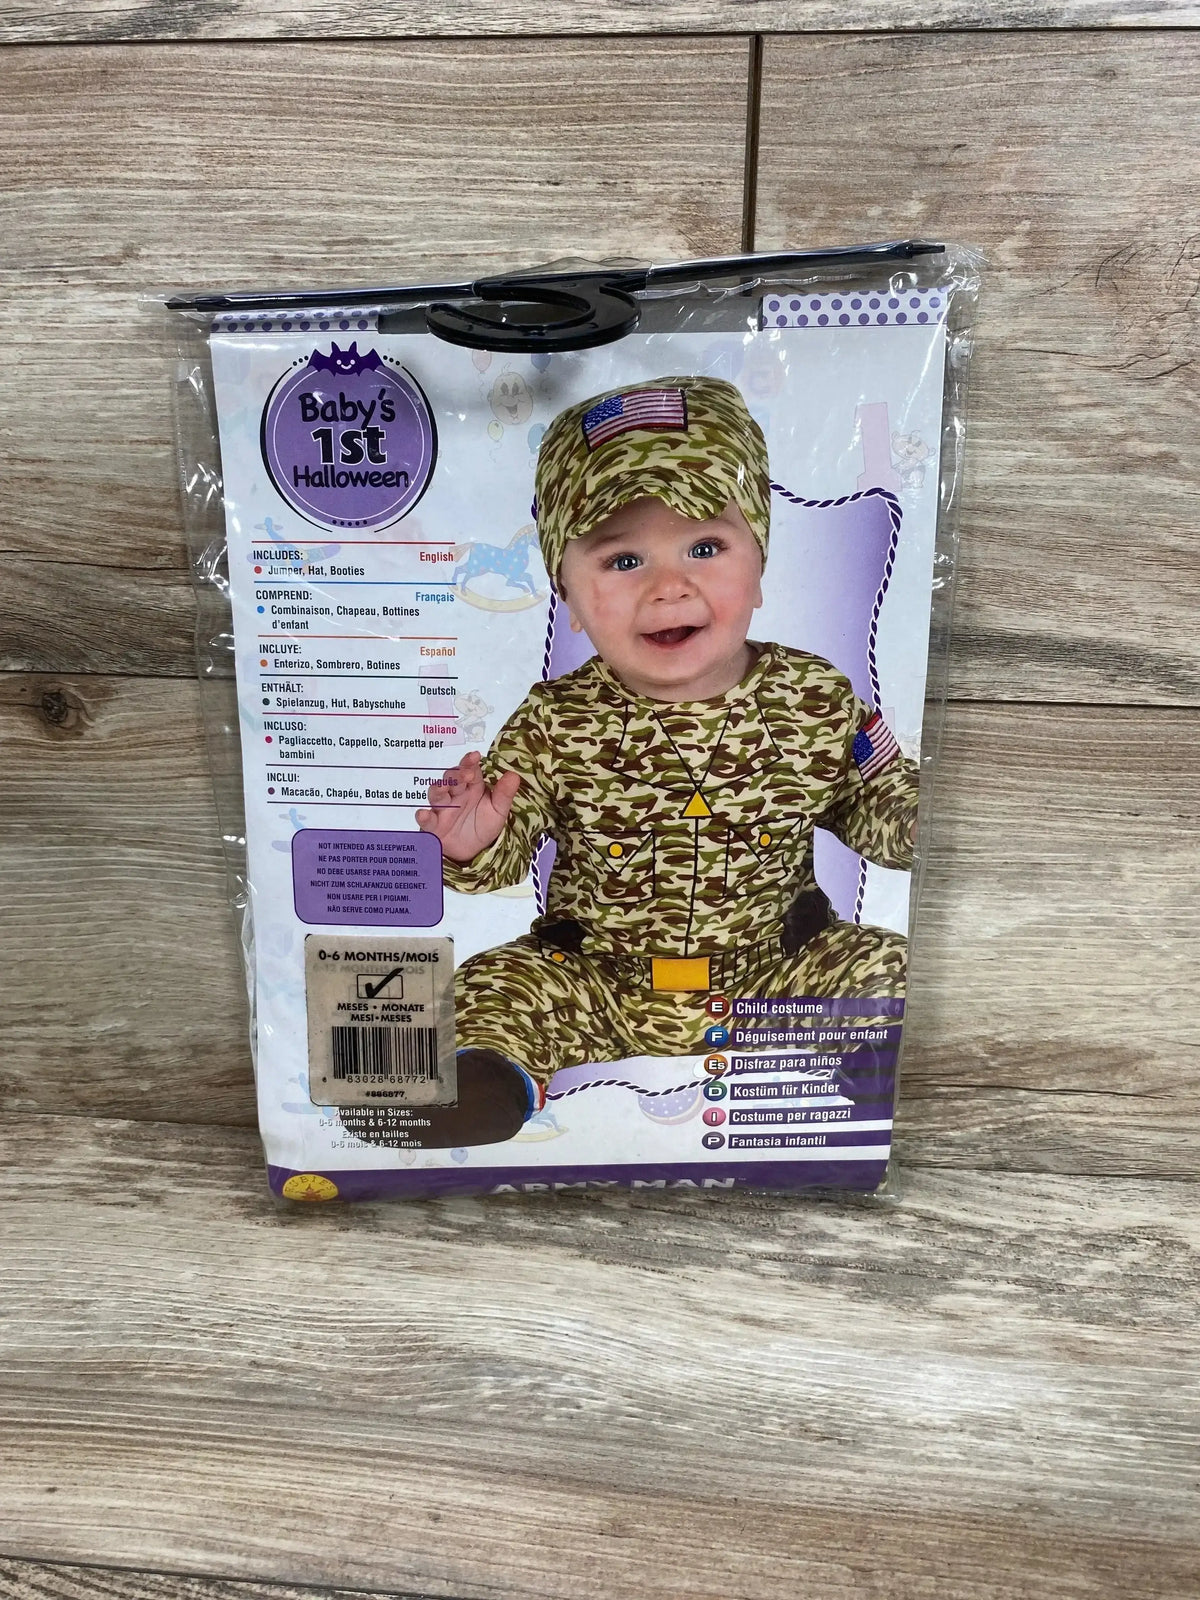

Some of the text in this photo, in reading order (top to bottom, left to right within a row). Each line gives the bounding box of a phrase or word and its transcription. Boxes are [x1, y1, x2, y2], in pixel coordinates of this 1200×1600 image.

[298, 388, 396, 430] Baby's
[311, 425, 388, 465] 1st
[293, 465, 409, 488] Halloween
[253, 550, 304, 560] INCLUDES:
[419, 552, 454, 564] English
[268, 566, 365, 577] Jumper, Hat, Booties
[255, 590, 312, 600] COMPREND:
[415, 592, 455, 604] Français
[271, 605, 420, 619] Combinaison, Chapeau, Bottines
[272, 620, 309, 630] d'enfant
[259, 644, 302, 654] INCLUYE:
[420, 647, 456, 659] Español
[274, 659, 401, 671] Enterizo, Sombrero, Botines
[420, 686, 456, 696] Deutsch
[276, 697, 406, 710] Spielanzug, Hut, Babyschuhe
[264, 721, 307, 731] INCLUSO:
[423, 724, 457, 735] Italiano
[278, 736, 444, 749] Pagliaccetto, Cappello, Scarpetta per
[279, 750, 315, 760] bambini
[267, 772, 300, 783] INCLUI:
[413, 776, 458, 788] Português
[281, 786, 427, 800] Macacão, Chapéu, Botas de bebé
[366, 843, 375, 851] AS
[376, 844, 417, 852] SLEEPWEAR.
[369, 856, 387, 864] POUR
[389, 857, 418, 865] DORMIR.
[391, 869, 420, 877] DORMIR.
[347, 881, 393, 889] SCHLAFANZUG
[394, 882, 428, 890] GEEIGNET.
[385, 907, 411, 915] PIJAMA.
[318, 949, 439, 963] 0-6 MONTHS/MOIS
[337, 1003, 425, 1012] MESES MONATE
[711, 1002, 823, 1014] E Child costume
[711, 1029, 888, 1044] F Déguisement pour enfant
[708, 1055, 842, 1071] Es Disfraz para niños
[347, 1075, 384, 1083] 83028
[390, 1075, 426, 1084] 68772
[708, 1082, 840, 1097] D Kostüm für Kinder
[335, 1108, 413, 1117] Available in Sizes:
[711, 1108, 851, 1123] I Costume per ragazzi
[335, 1119, 366, 1127] months
[368, 1119, 375, 1127] &
[377, 1119, 397, 1127] 6-12
[400, 1119, 431, 1127] months
[342, 1130, 367, 1138] Existe
[382, 1130, 409, 1138] tailles
[707, 1136, 826, 1146] P Fantasia infantil
